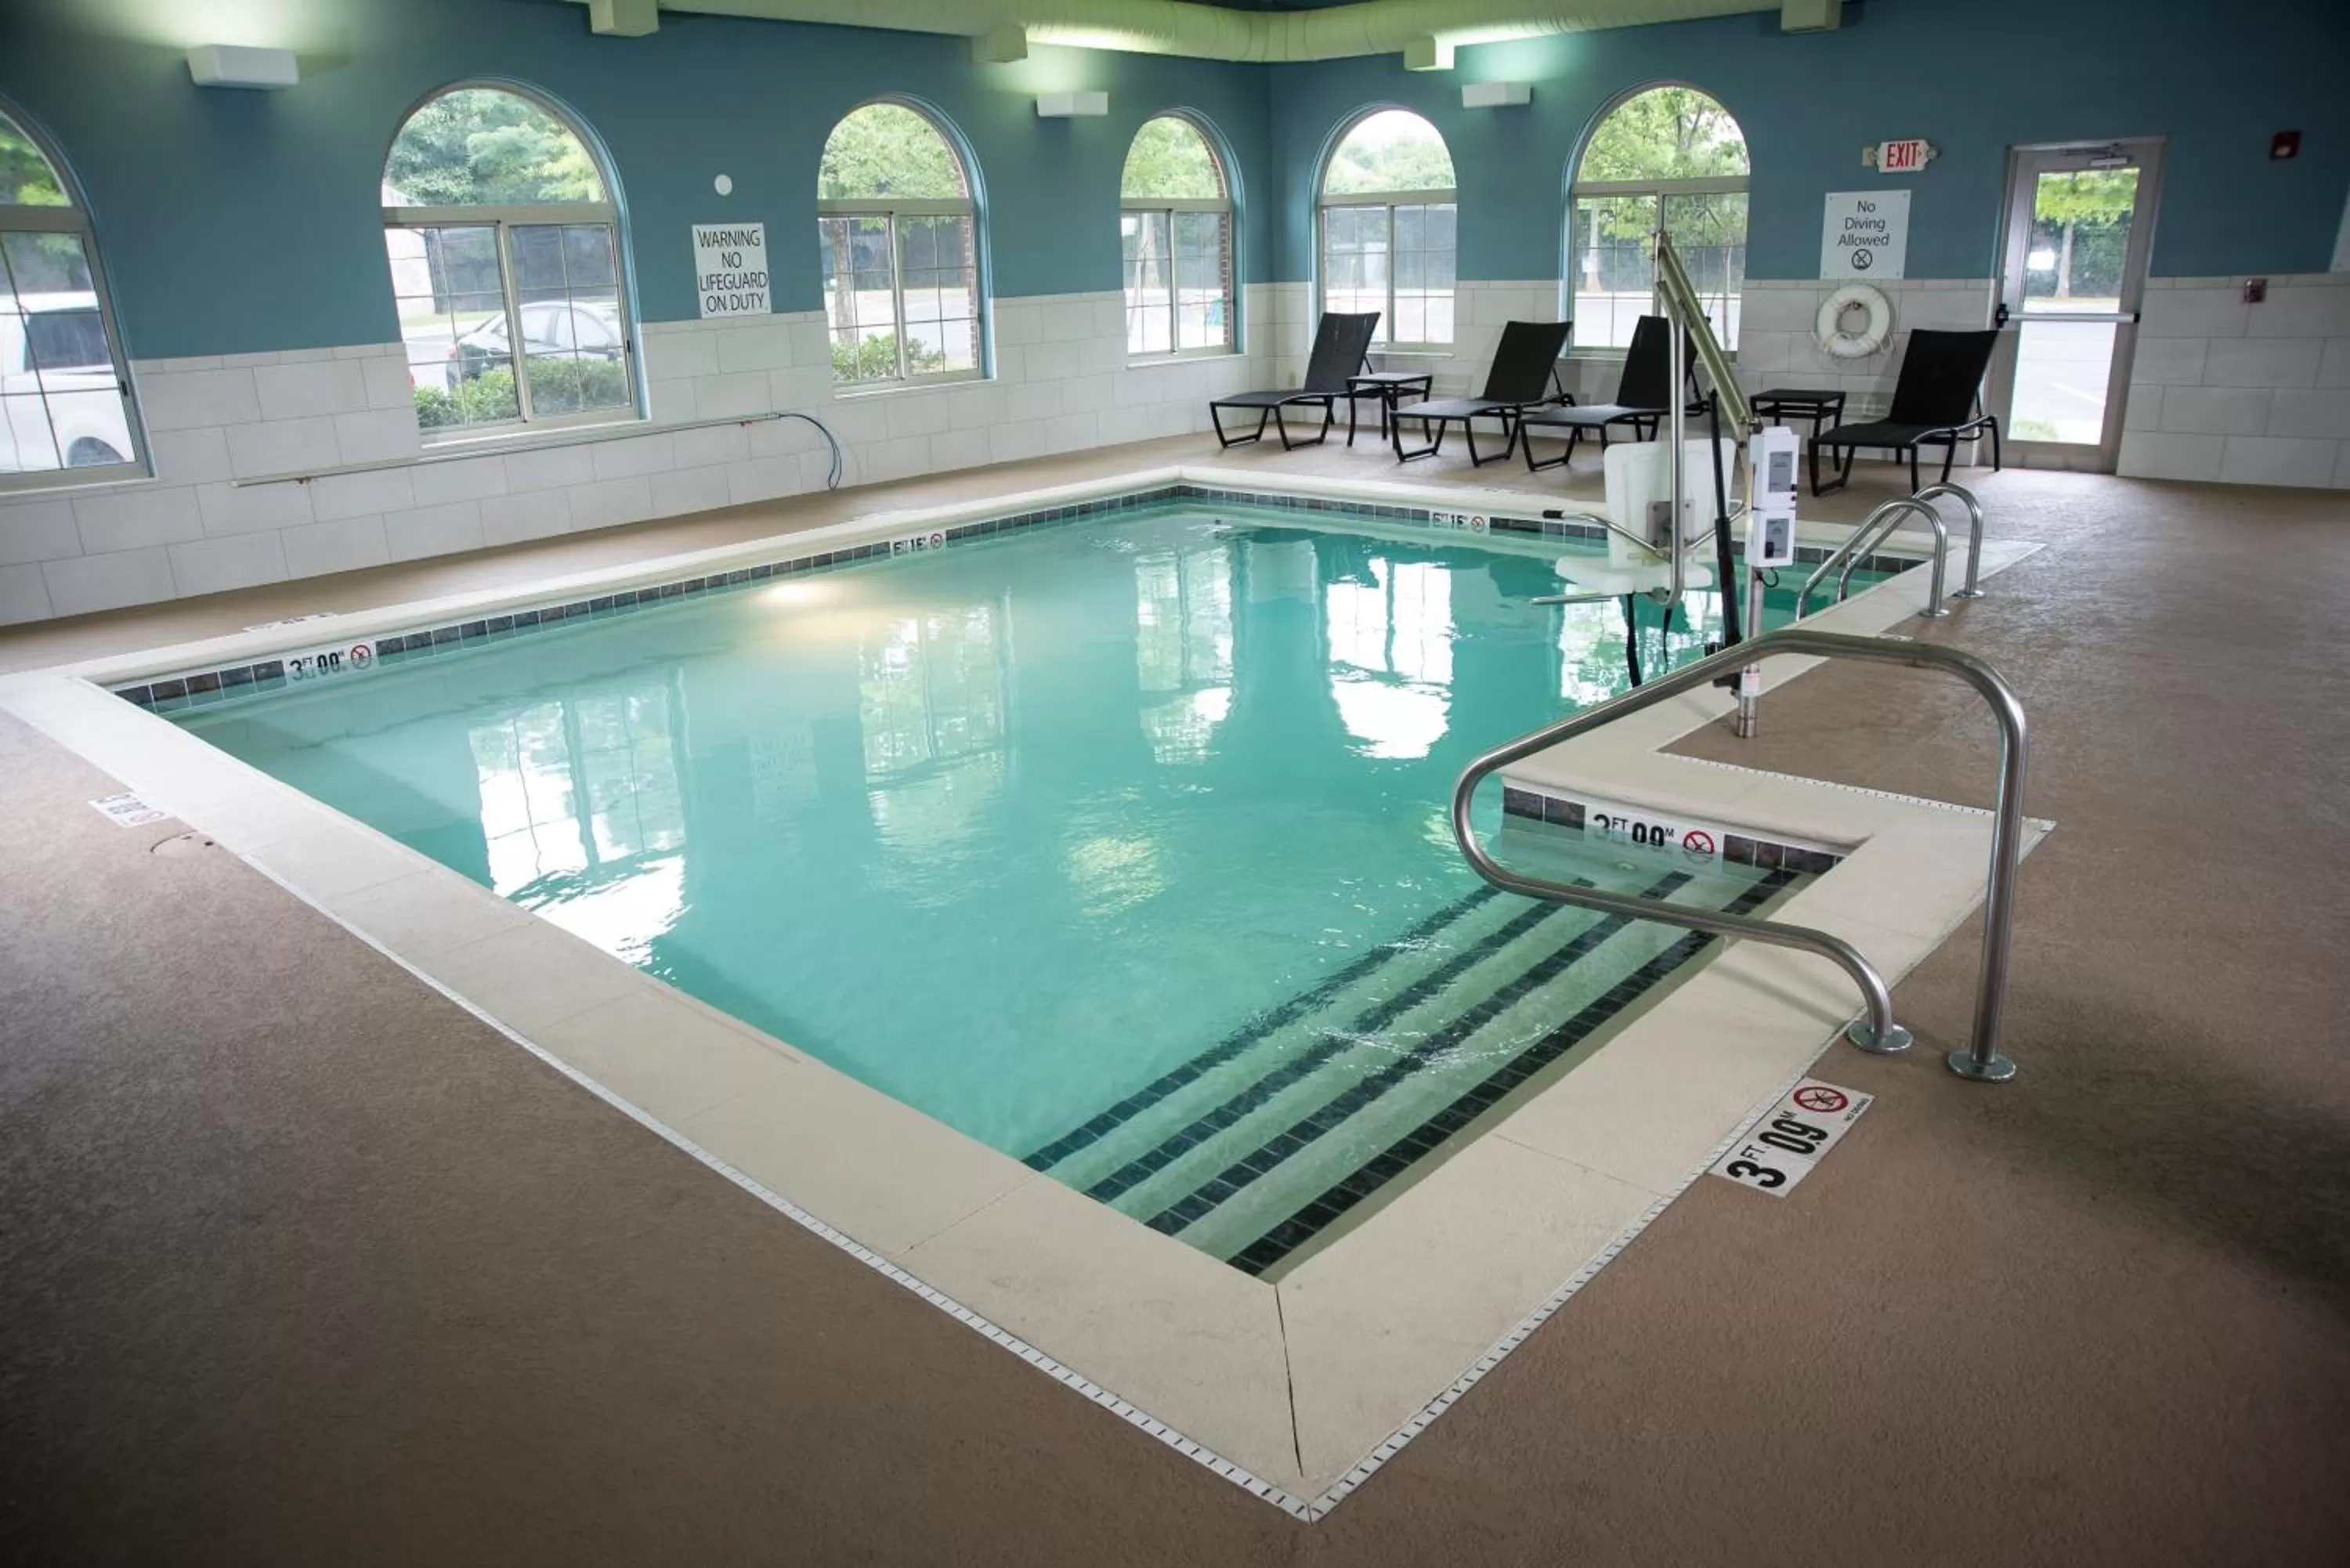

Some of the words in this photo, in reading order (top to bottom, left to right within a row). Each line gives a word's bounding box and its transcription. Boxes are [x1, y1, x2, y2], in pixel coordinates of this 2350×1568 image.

[1886, 143, 1919, 168] EXIT
[1857, 201, 1876, 213] No
[1845, 217, 1885, 232] Diving
[697, 229, 761, 248] WARNING
[1837, 233, 1890, 247] Allowed
[721, 251, 742, 268] NO
[699, 272, 768, 291] LIFEGUARD
[707, 295, 727, 312] ON
[729, 293, 765, 311] DUTY
